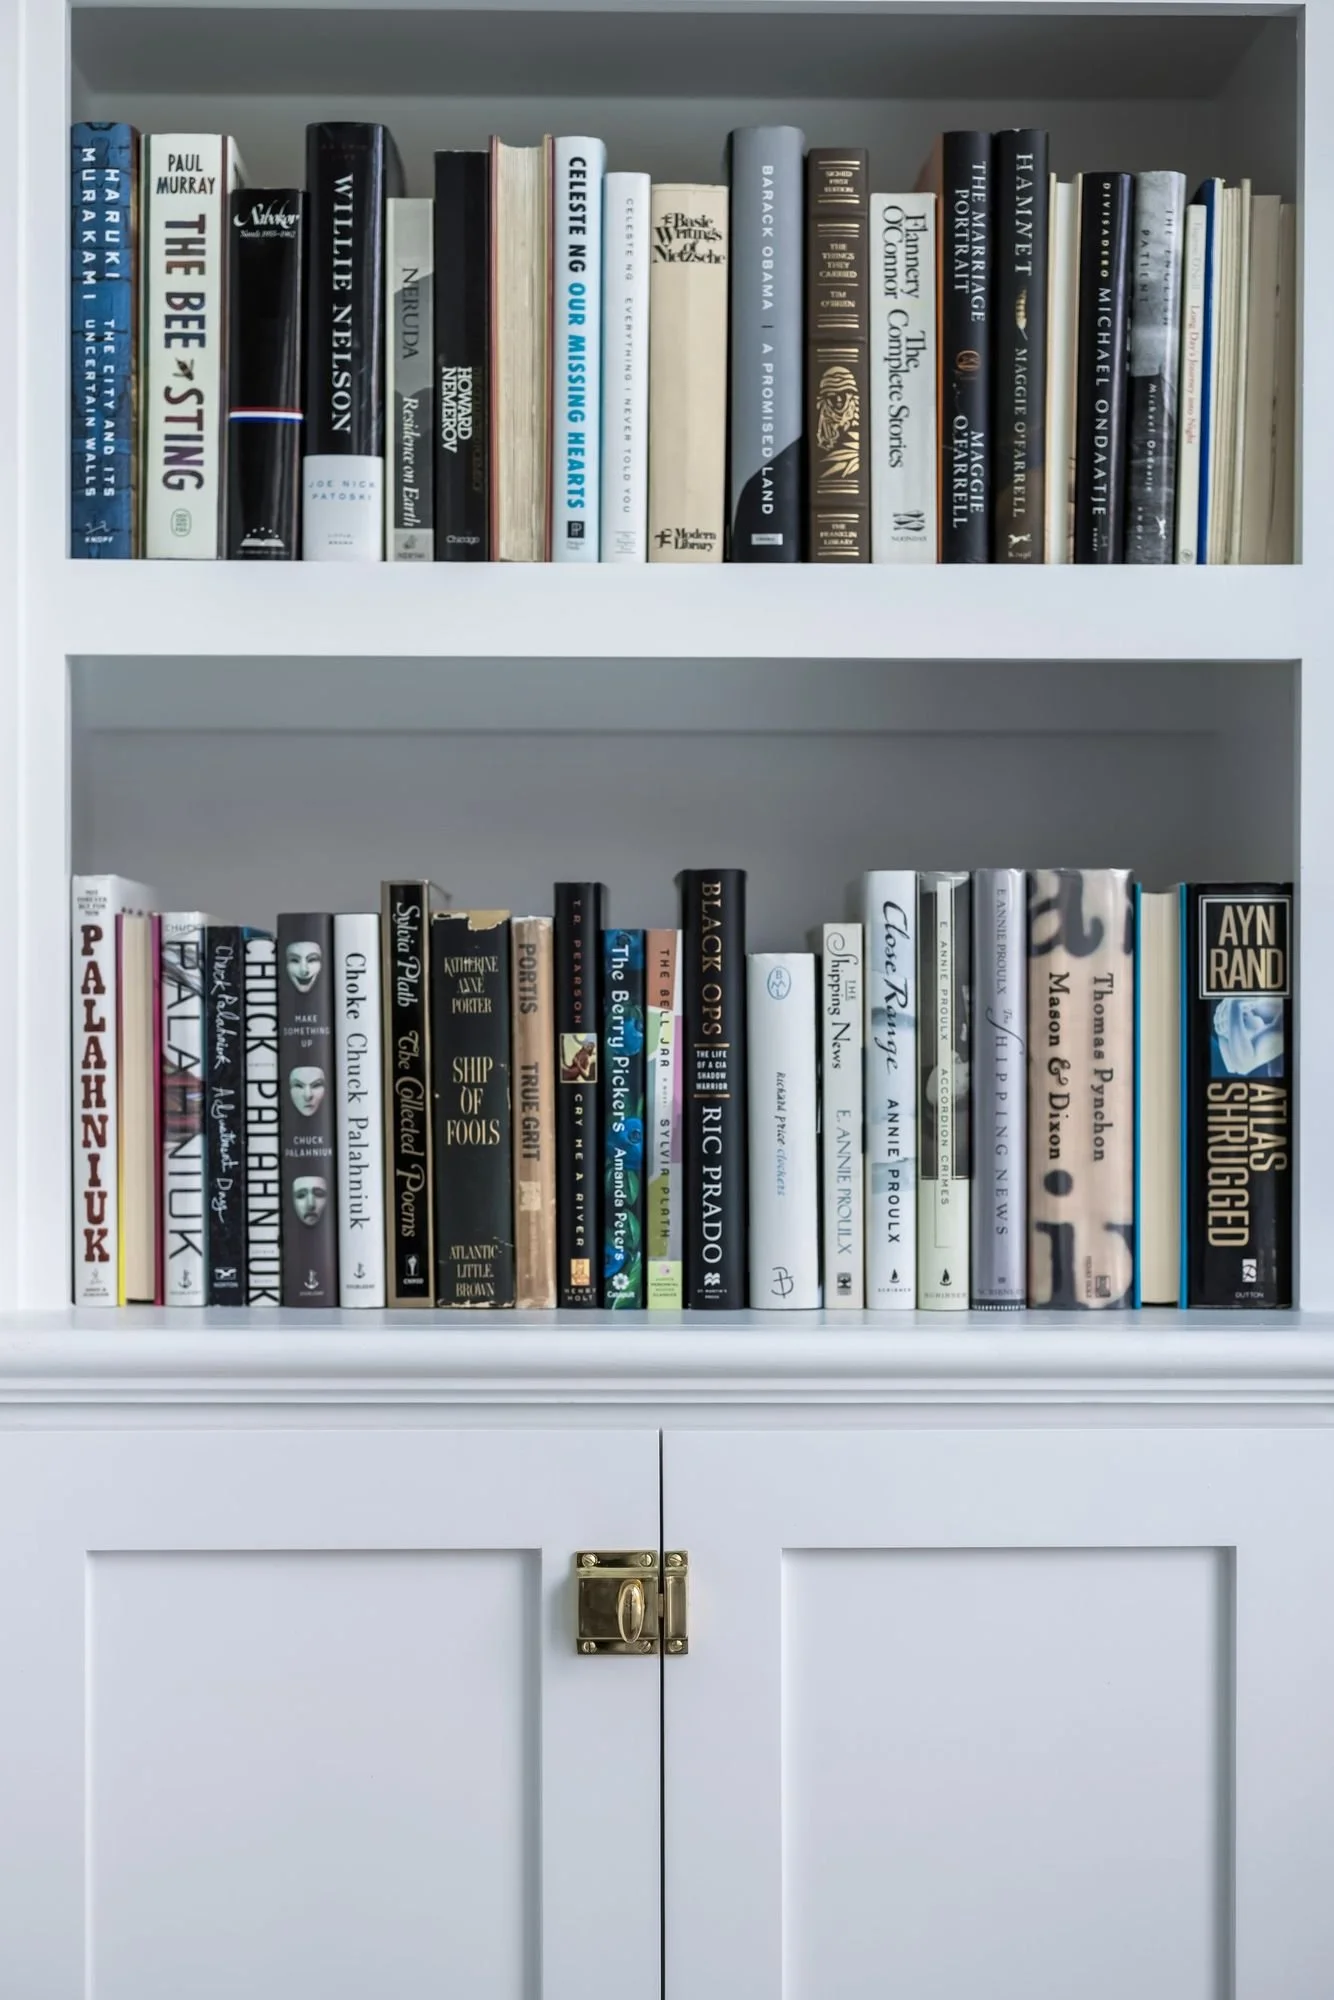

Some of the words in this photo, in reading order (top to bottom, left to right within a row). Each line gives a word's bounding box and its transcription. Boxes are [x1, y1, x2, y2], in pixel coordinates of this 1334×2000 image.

[156, 175, 216, 196] MURRAY
[168, 154, 204, 173] PAUL
[971, 161, 986, 205] THE
[568, 156, 587, 236] CELESTE
[673, 212, 714, 229] Basic
[761, 164, 774, 238] BARACK
[1015, 152, 1033, 277] HAMNET
[82, 147, 97, 300] MURAKAMI
[103, 169, 121, 279] HARUKI
[164, 213, 206, 276] THE
[332, 173, 354, 291] WILLIE
[625, 197, 634, 257] CELESTE
[654, 226, 722, 247] Writings
[953, 188, 970, 295] PORTRAIT
[1100, 182, 1111, 278] DIVISADERO
[568, 244, 587, 273] NG
[624, 263, 634, 281] NG
[652, 244, 726, 264] Nietzsche
[761, 245, 774, 311] OBAMA
[900, 213, 928, 298] Flannery
[970, 211, 985, 323] MARRIAGE
[163, 292, 206, 349] BEE
[402, 267, 419, 360] NERUDA
[567, 281, 586, 327] OUR
[1187, 304, 1200, 329] Long
[102, 319, 115, 354] THE
[624, 296, 633, 382] EVERYTHING
[761, 343, 774, 354] A
[883, 308, 910, 402] Complete
[905, 330, 927, 369] The
[1096, 287, 1110, 386] MICHAEL
[84, 319, 97, 427] UNCERTAIN
[102, 362, 116, 412] CITY
[331, 303, 353, 433] NELSON
[567, 334, 586, 424] MISSING
[1014, 347, 1028, 417] MAGGIE
[401, 396, 421, 464] Residence
[441, 366, 458, 453] NEMEROV
[457, 366, 473, 440] HOWARD
[623, 399, 632, 442] NEVER
[761, 362, 775, 458] PROMISED
[102, 419, 116, 456] AND
[161, 386, 205, 491] STING
[888, 404, 911, 469] Stories
[1091, 398, 1107, 516] ONDAATJE
[85, 437, 97, 498] WALLS
[102, 465, 116, 498] ITS
[309, 480, 334, 489] JOE
[342, 480, 377, 489] NICK
[403, 465, 417, 483] on
[567, 431, 585, 509] HEARTS
[623, 447, 632, 482] TOLD
[761, 466, 774, 515] LAND
[952, 414, 969, 529] O'FARRELL
[969, 430, 985, 514] MAGGIE
[1012, 420, 1027, 518] O'FARRELL
[402, 486, 421, 527] Earth
[622, 486, 632, 514] YOU
[673, 538, 715, 551] Library
[674, 527, 717, 540] Modern
[392, 902, 421, 953] Sylvia
[701, 881, 722, 973] BLACK
[883, 900, 910, 975] Close
[1217, 904, 1276, 947] AYN
[210, 945, 234, 994] Chuck
[344, 952, 367, 1020] Choke
[396, 956, 421, 1007] Plath
[444, 956, 499, 977] KATHERINE
[456, 977, 485, 994] ANNE
[518, 943, 538, 1015] PORTIS
[609, 944, 629, 981] The
[659, 949, 670, 980] THE
[826, 931, 859, 1016] Shipping
[1210, 948, 1284, 990] RAND
[246, 940, 278, 1053] CHUCK
[451, 998, 492, 1014] PORTER
[659, 988, 670, 1028] BELL
[701, 982, 722, 1036] OPS
[847, 979, 857, 1001] THE
[1048, 971, 1071, 1047] Mason
[1092, 972, 1114, 1060] Thomas
[283, 1026, 330, 1036] SOMETHING
[295, 1014, 319, 1022] MAKE
[301, 1040, 313, 1048] UP
[608, 988, 630, 1049] Berry
[831, 1021, 852, 1069] News
[874, 977, 908, 1076] Range
[346, 1033, 368, 1105] Chuck
[397, 1030, 420, 1070] The
[452, 1056, 494, 1084] SHIP
[659, 1037, 670, 1068] JAR
[697, 1050, 709, 1059] THE
[711, 1050, 727, 1059] LIFE
[697, 1061, 706, 1069] OF
[708, 1061, 713, 1069] A
[715, 1061, 727, 1069] CIA
[697, 1072, 727, 1080] SHADOW
[1048, 1055, 1071, 1087] &
[80, 924, 110, 1263] PALAHNIUK
[166, 941, 204, 1260] PALAHNIUK
[460, 1086, 485, 1113] OF
[519, 1061, 539, 1110] TRUE
[574, 1093, 584, 1127] CRY
[610, 1055, 630, 1133] Pickers
[696, 1083, 728, 1091] WARRIOR
[775, 1071, 786, 1113] Richard
[211, 1086, 239, 1173] Adjustment
[293, 1136, 324, 1145] CHUCK
[395, 1076, 424, 1155] Collected
[446, 1119, 500, 1146] FOOLS
[520, 1115, 540, 1163] GRIT
[702, 1105, 722, 1156] RIC
[887, 1099, 900, 1158] ANNIE
[1048, 1092, 1071, 1161] Dixon
[1091, 1067, 1114, 1162] Pynchon
[1248, 1082, 1288, 1172] ATLAS
[285, 1147, 333, 1157] PALAHNIUK
[347, 1116, 370, 1230] Palahniuk
[574, 1138, 584, 1161] ME
[659, 1118, 670, 1177] SYLVIA
[775, 1147, 786, 1197] clockers
[836, 1127, 852, 1183] ANNIE
[1206, 1081, 1249, 1248] SHRUGGED
[246, 1080, 280, 1304] PALAHNIUK
[396, 1163, 424, 1238] Poems
[575, 1172, 584, 1182] A
[612, 1146, 627, 1208] Amanda
[575, 1193, 585, 1248] RIVER
[660, 1186, 671, 1239] PLATH
[702, 1165, 723, 1264] PRADO
[837, 1188, 853, 1255] PROULX
[887, 1168, 901, 1245] PROULX
[612, 1211, 627, 1262] Peters
[456, 1282, 495, 1297] BROWN
